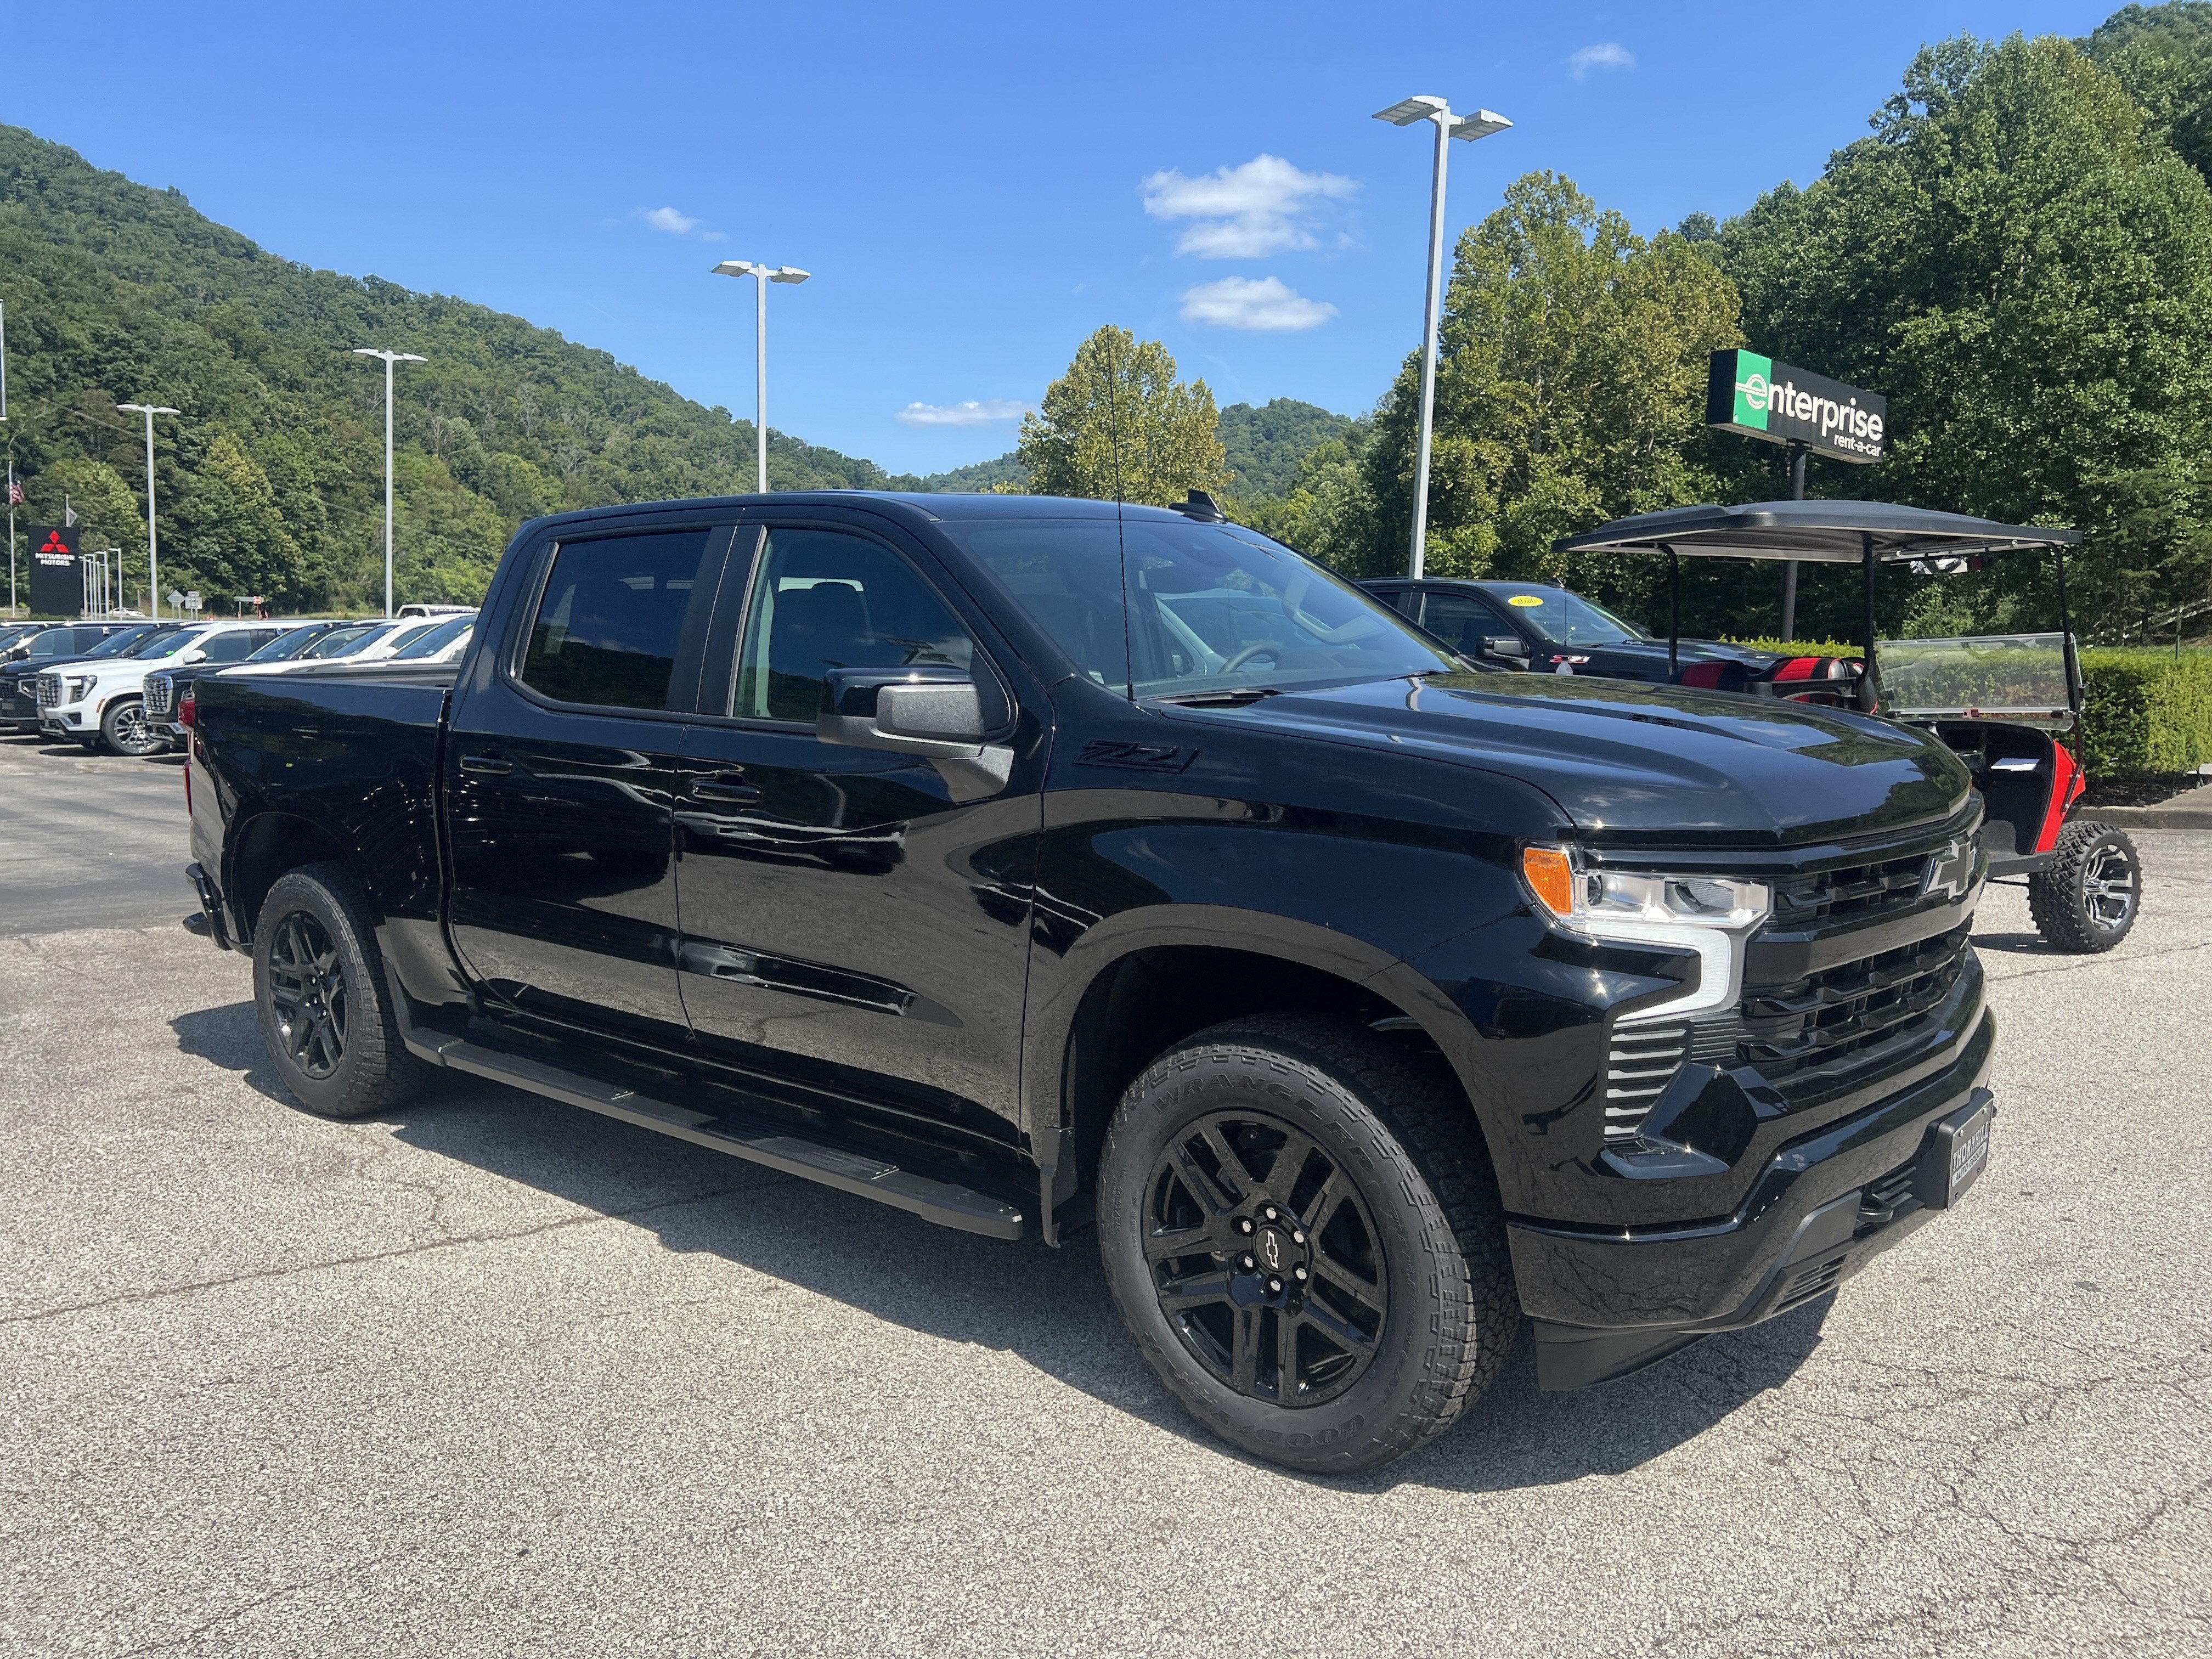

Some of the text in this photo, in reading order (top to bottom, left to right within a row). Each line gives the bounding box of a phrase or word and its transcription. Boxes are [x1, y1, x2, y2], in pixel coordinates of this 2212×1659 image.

[1735, 374, 1883, 441] enterprise
[1833, 433, 1882, 458] rent-a-car
[1072, 739, 1201, 775] Z71
[1153, 1073, 1375, 1170] WRANGLER
[1953, 1121, 1989, 1172] THORNHILL
